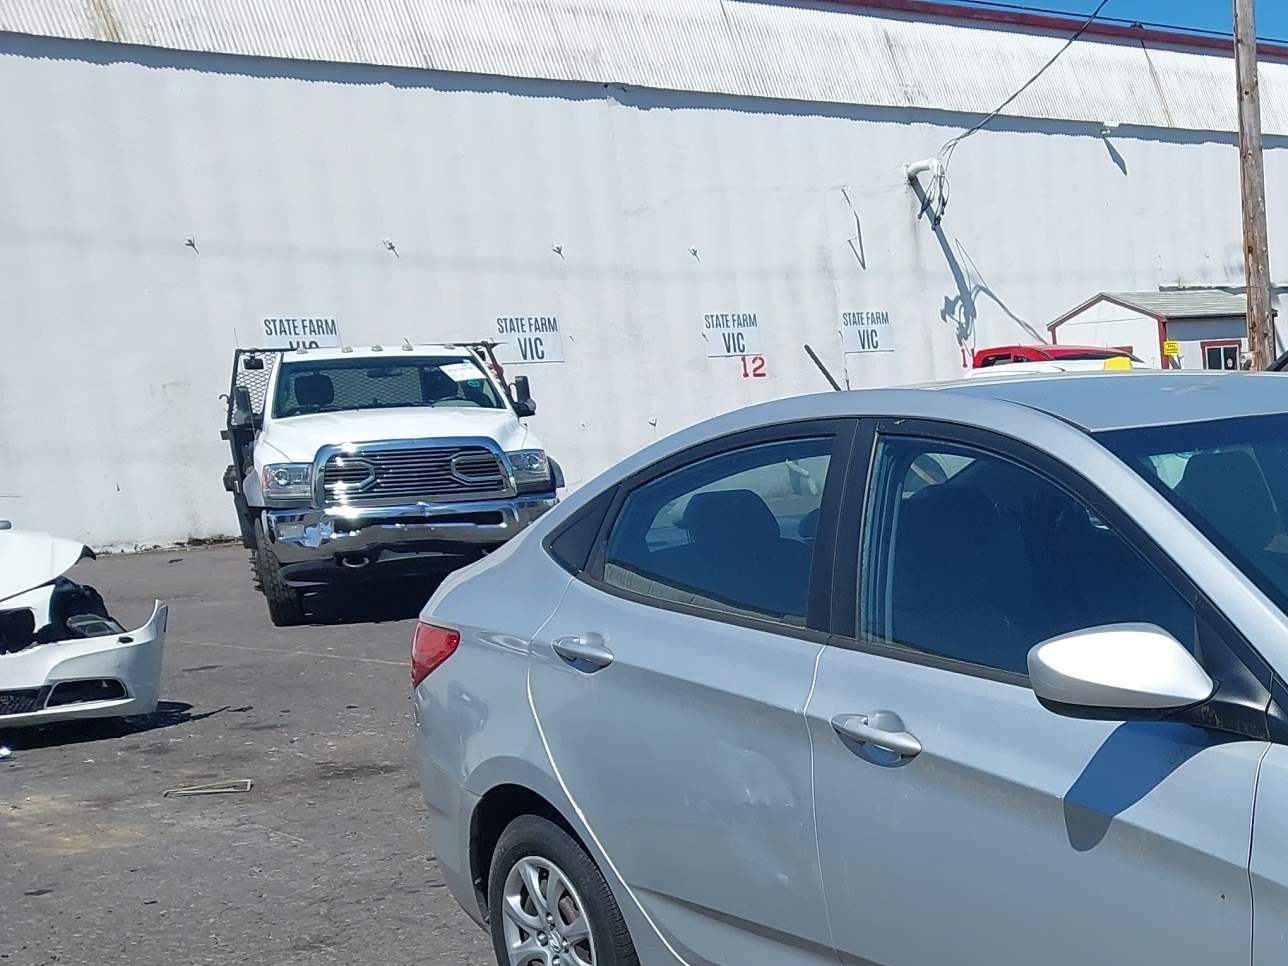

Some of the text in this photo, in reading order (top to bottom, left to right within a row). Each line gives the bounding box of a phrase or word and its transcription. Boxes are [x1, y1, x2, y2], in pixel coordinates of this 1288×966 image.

[263, 319, 337, 336] STATE FARM
[496, 317, 558, 334] STATE FARM
[704, 313, 758, 329] STATE FARM
[842, 311, 889, 326] STATE FARM
[722, 332, 746, 353] VIC
[857, 329, 879, 349] VIC
[517, 337, 545, 360] VIC
[741, 356, 766, 377] 12
